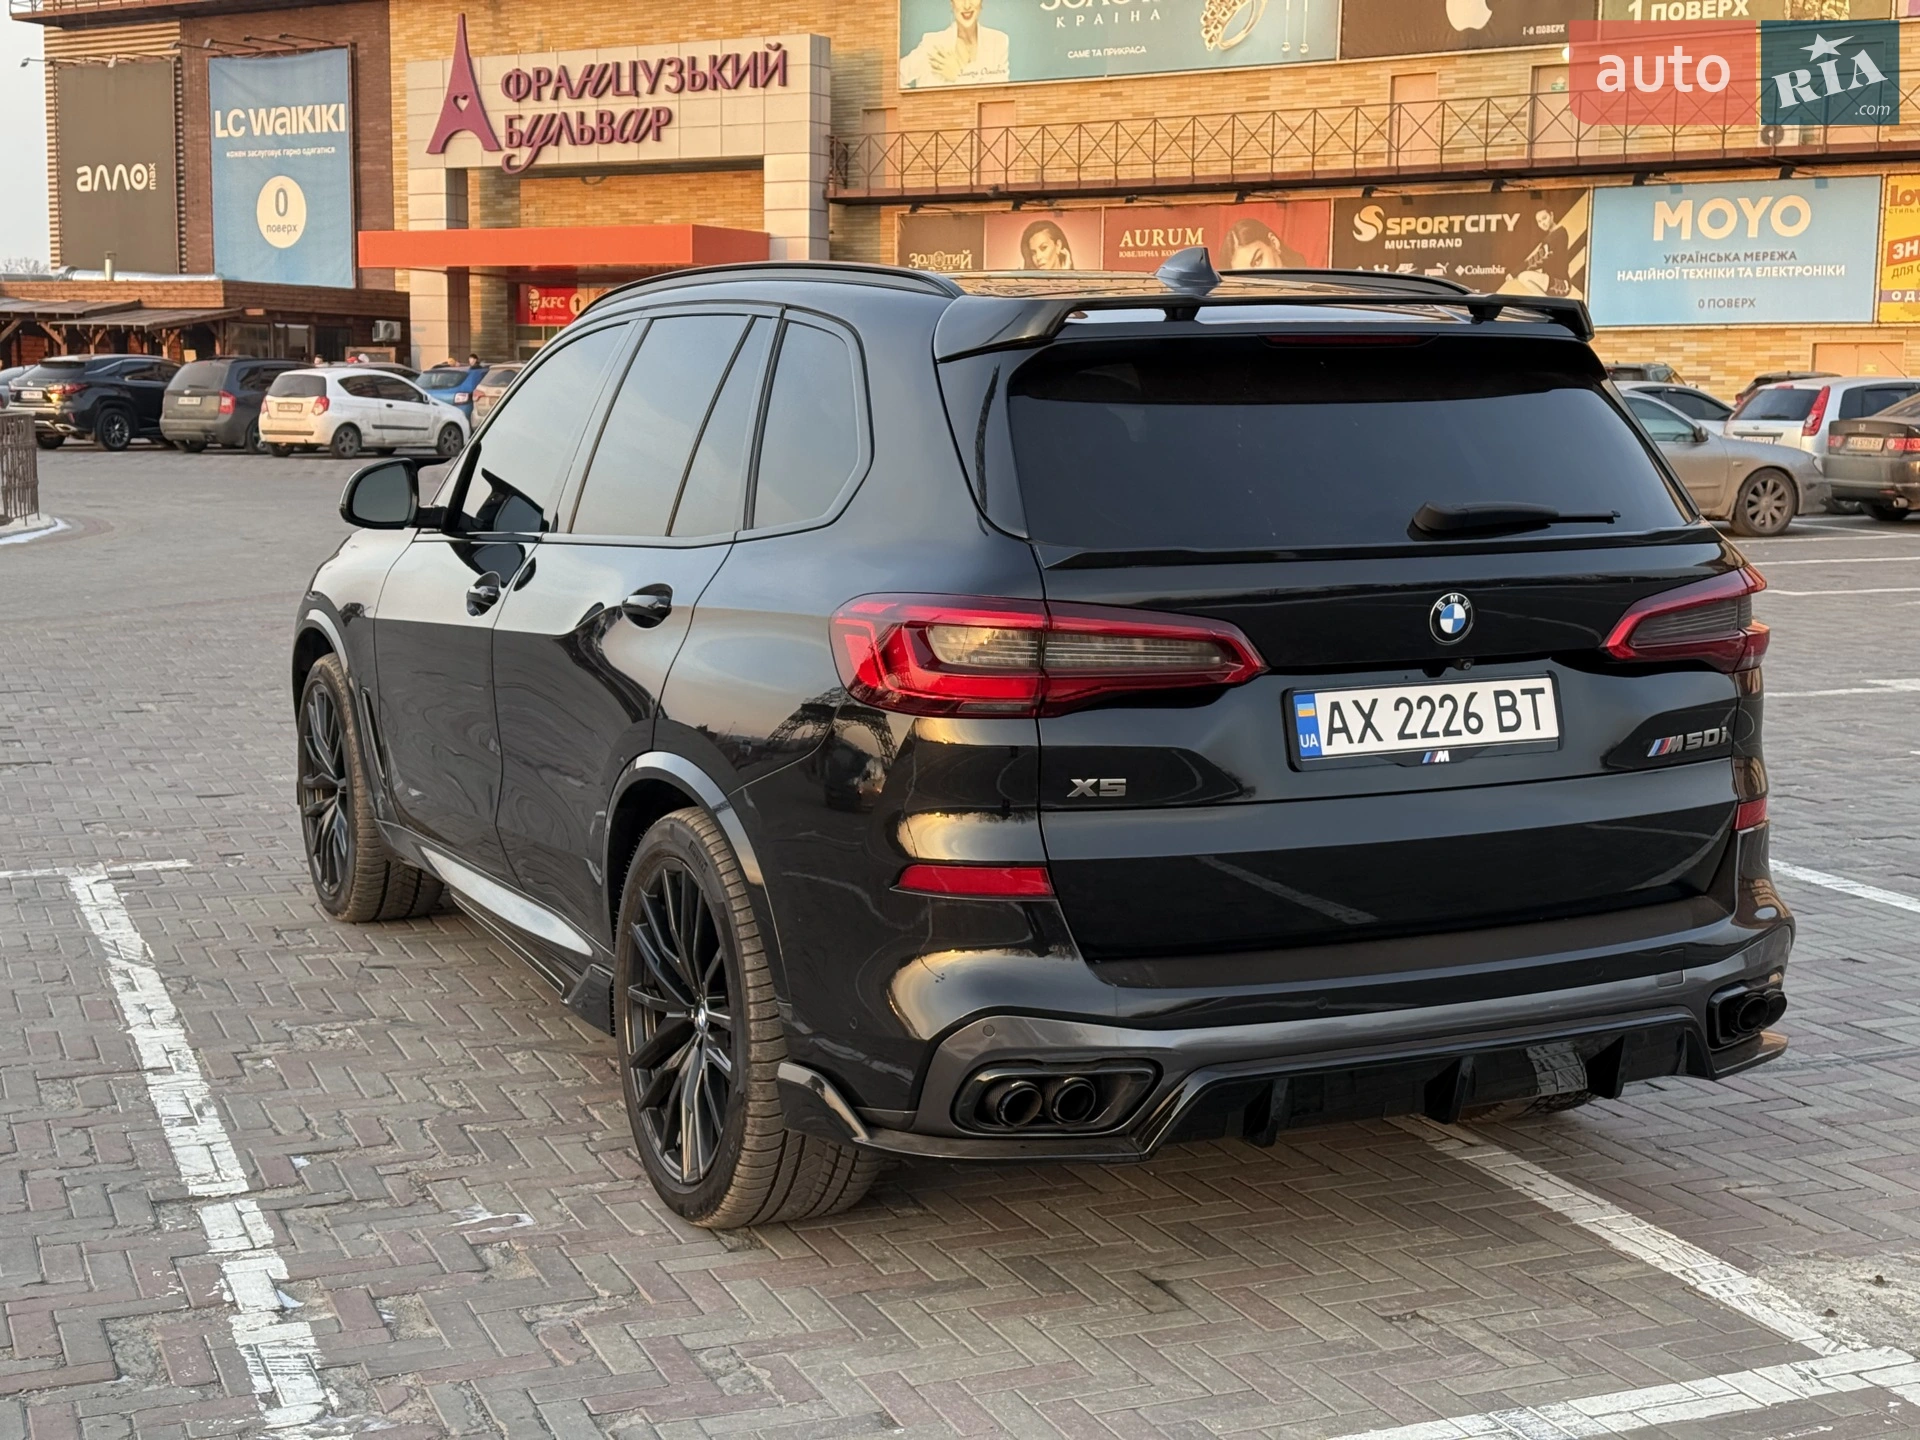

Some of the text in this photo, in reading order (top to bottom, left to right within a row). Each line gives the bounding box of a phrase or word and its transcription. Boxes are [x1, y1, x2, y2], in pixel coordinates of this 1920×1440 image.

[1627, 0, 1750, 24] 1 ПОВЕРХ
[1067, 46, 1147, 59] САМЕ ТА ПРИКРАСА
[501, 42, 787, 102] ФРАНЦУЗЬКИЙ
[214, 108, 246, 138] LC
[148, 163, 157, 190] max
[275, 187, 288, 217] 0
[1386, 213, 1521, 236] SPORTCITY
[1653, 195, 1812, 241] MOYO
[266, 223, 298, 235] поверх
[1119, 227, 1204, 247] AURUM
[1384, 238, 1462, 250] MULTIBRAND
[1892, 239, 1920, 260] ЗН
[908, 249, 972, 269] ЗОЛОТИЙ
[1119, 250, 1159, 258] ЮВЕЛІРНА
[1663, 250, 1797, 264] УКРАЇНСЬКА МЕРЕЖА
[1464, 265, 1506, 276] Columbia
[1617, 265, 1846, 282] НАДІЙНОЇ ТЕХНІКИ ТА ЕЛЕКТРОНІКИ
[1891, 265, 1914, 280] ДЛЯ
[540, 297, 565, 309] KFC
[1707, 297, 1756, 309] ПОВЕРХ
[1891, 290, 1920, 303] ОД
[1436, 594, 1471, 611] BMW
[1326, 687, 1545, 746] AX 2226 BT
[1301, 734, 1319, 748] UA
[1066, 778, 1127, 797] X5
